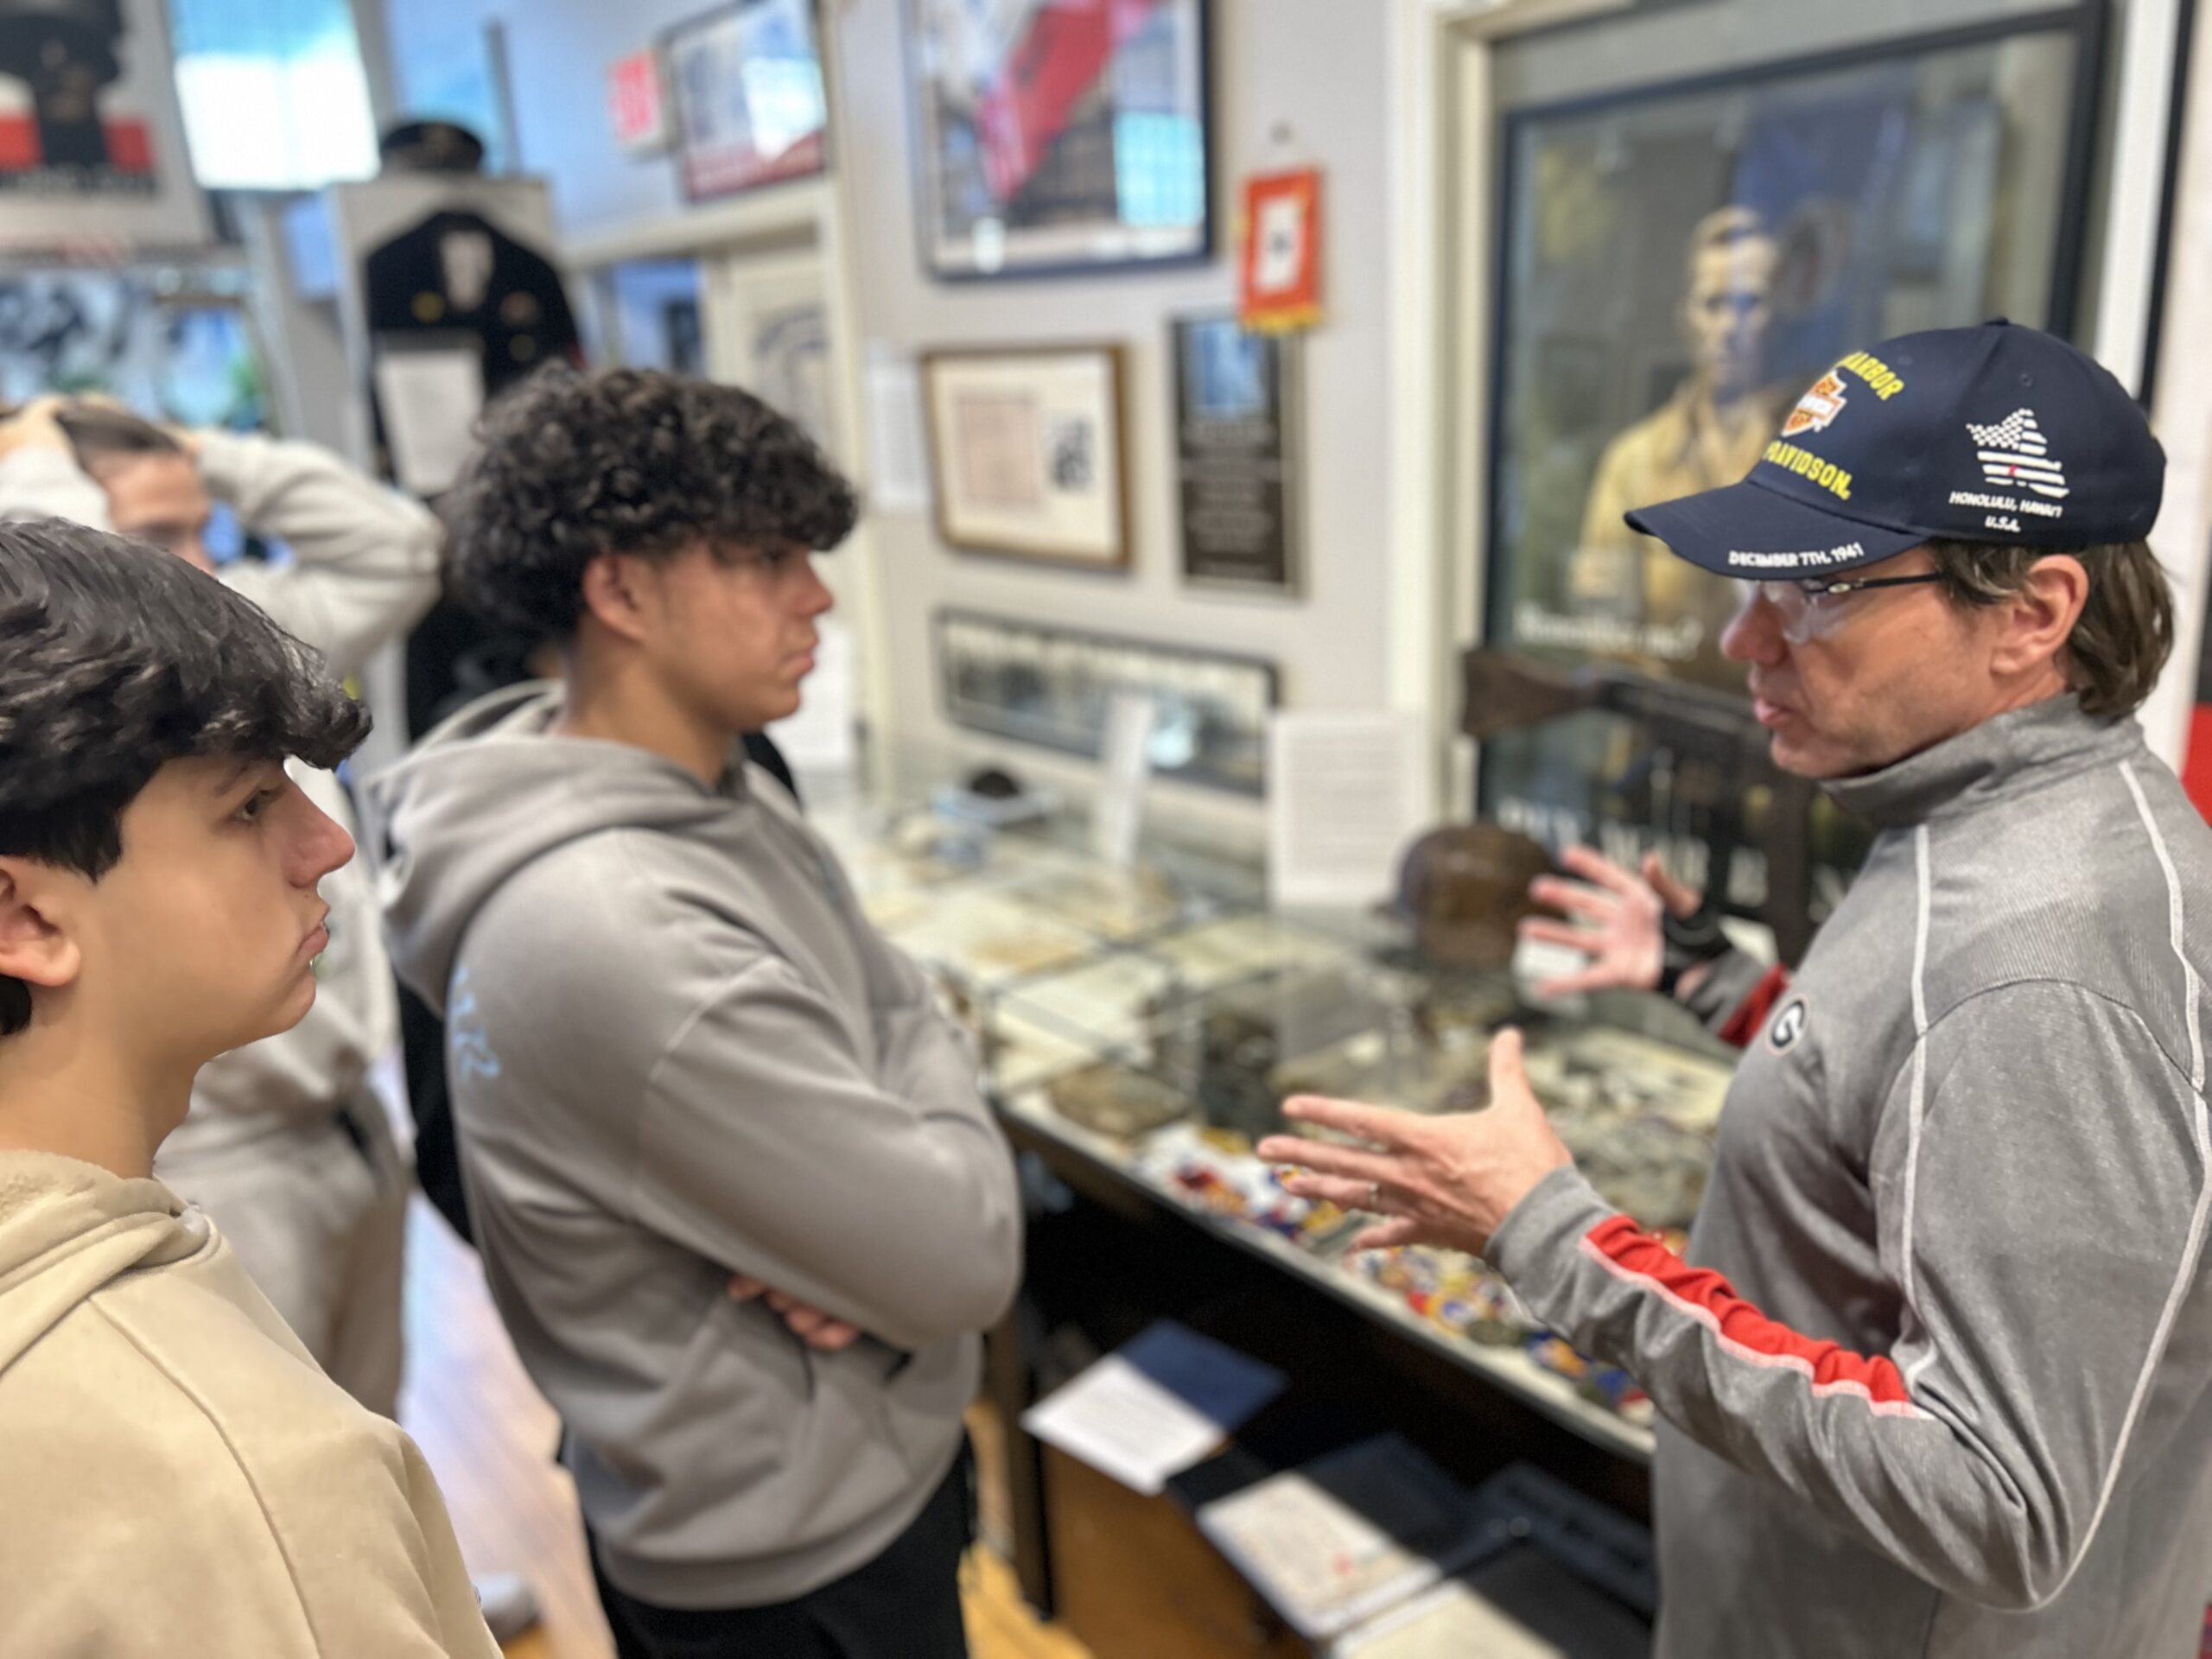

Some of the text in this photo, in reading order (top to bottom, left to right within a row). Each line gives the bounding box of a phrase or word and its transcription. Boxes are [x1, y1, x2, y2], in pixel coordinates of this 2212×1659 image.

[1948, 491, 2018, 512] HONOLULU,
[1728, 550, 1798, 567] DECEMBER
[1829, 541, 1865, 563] 1941
